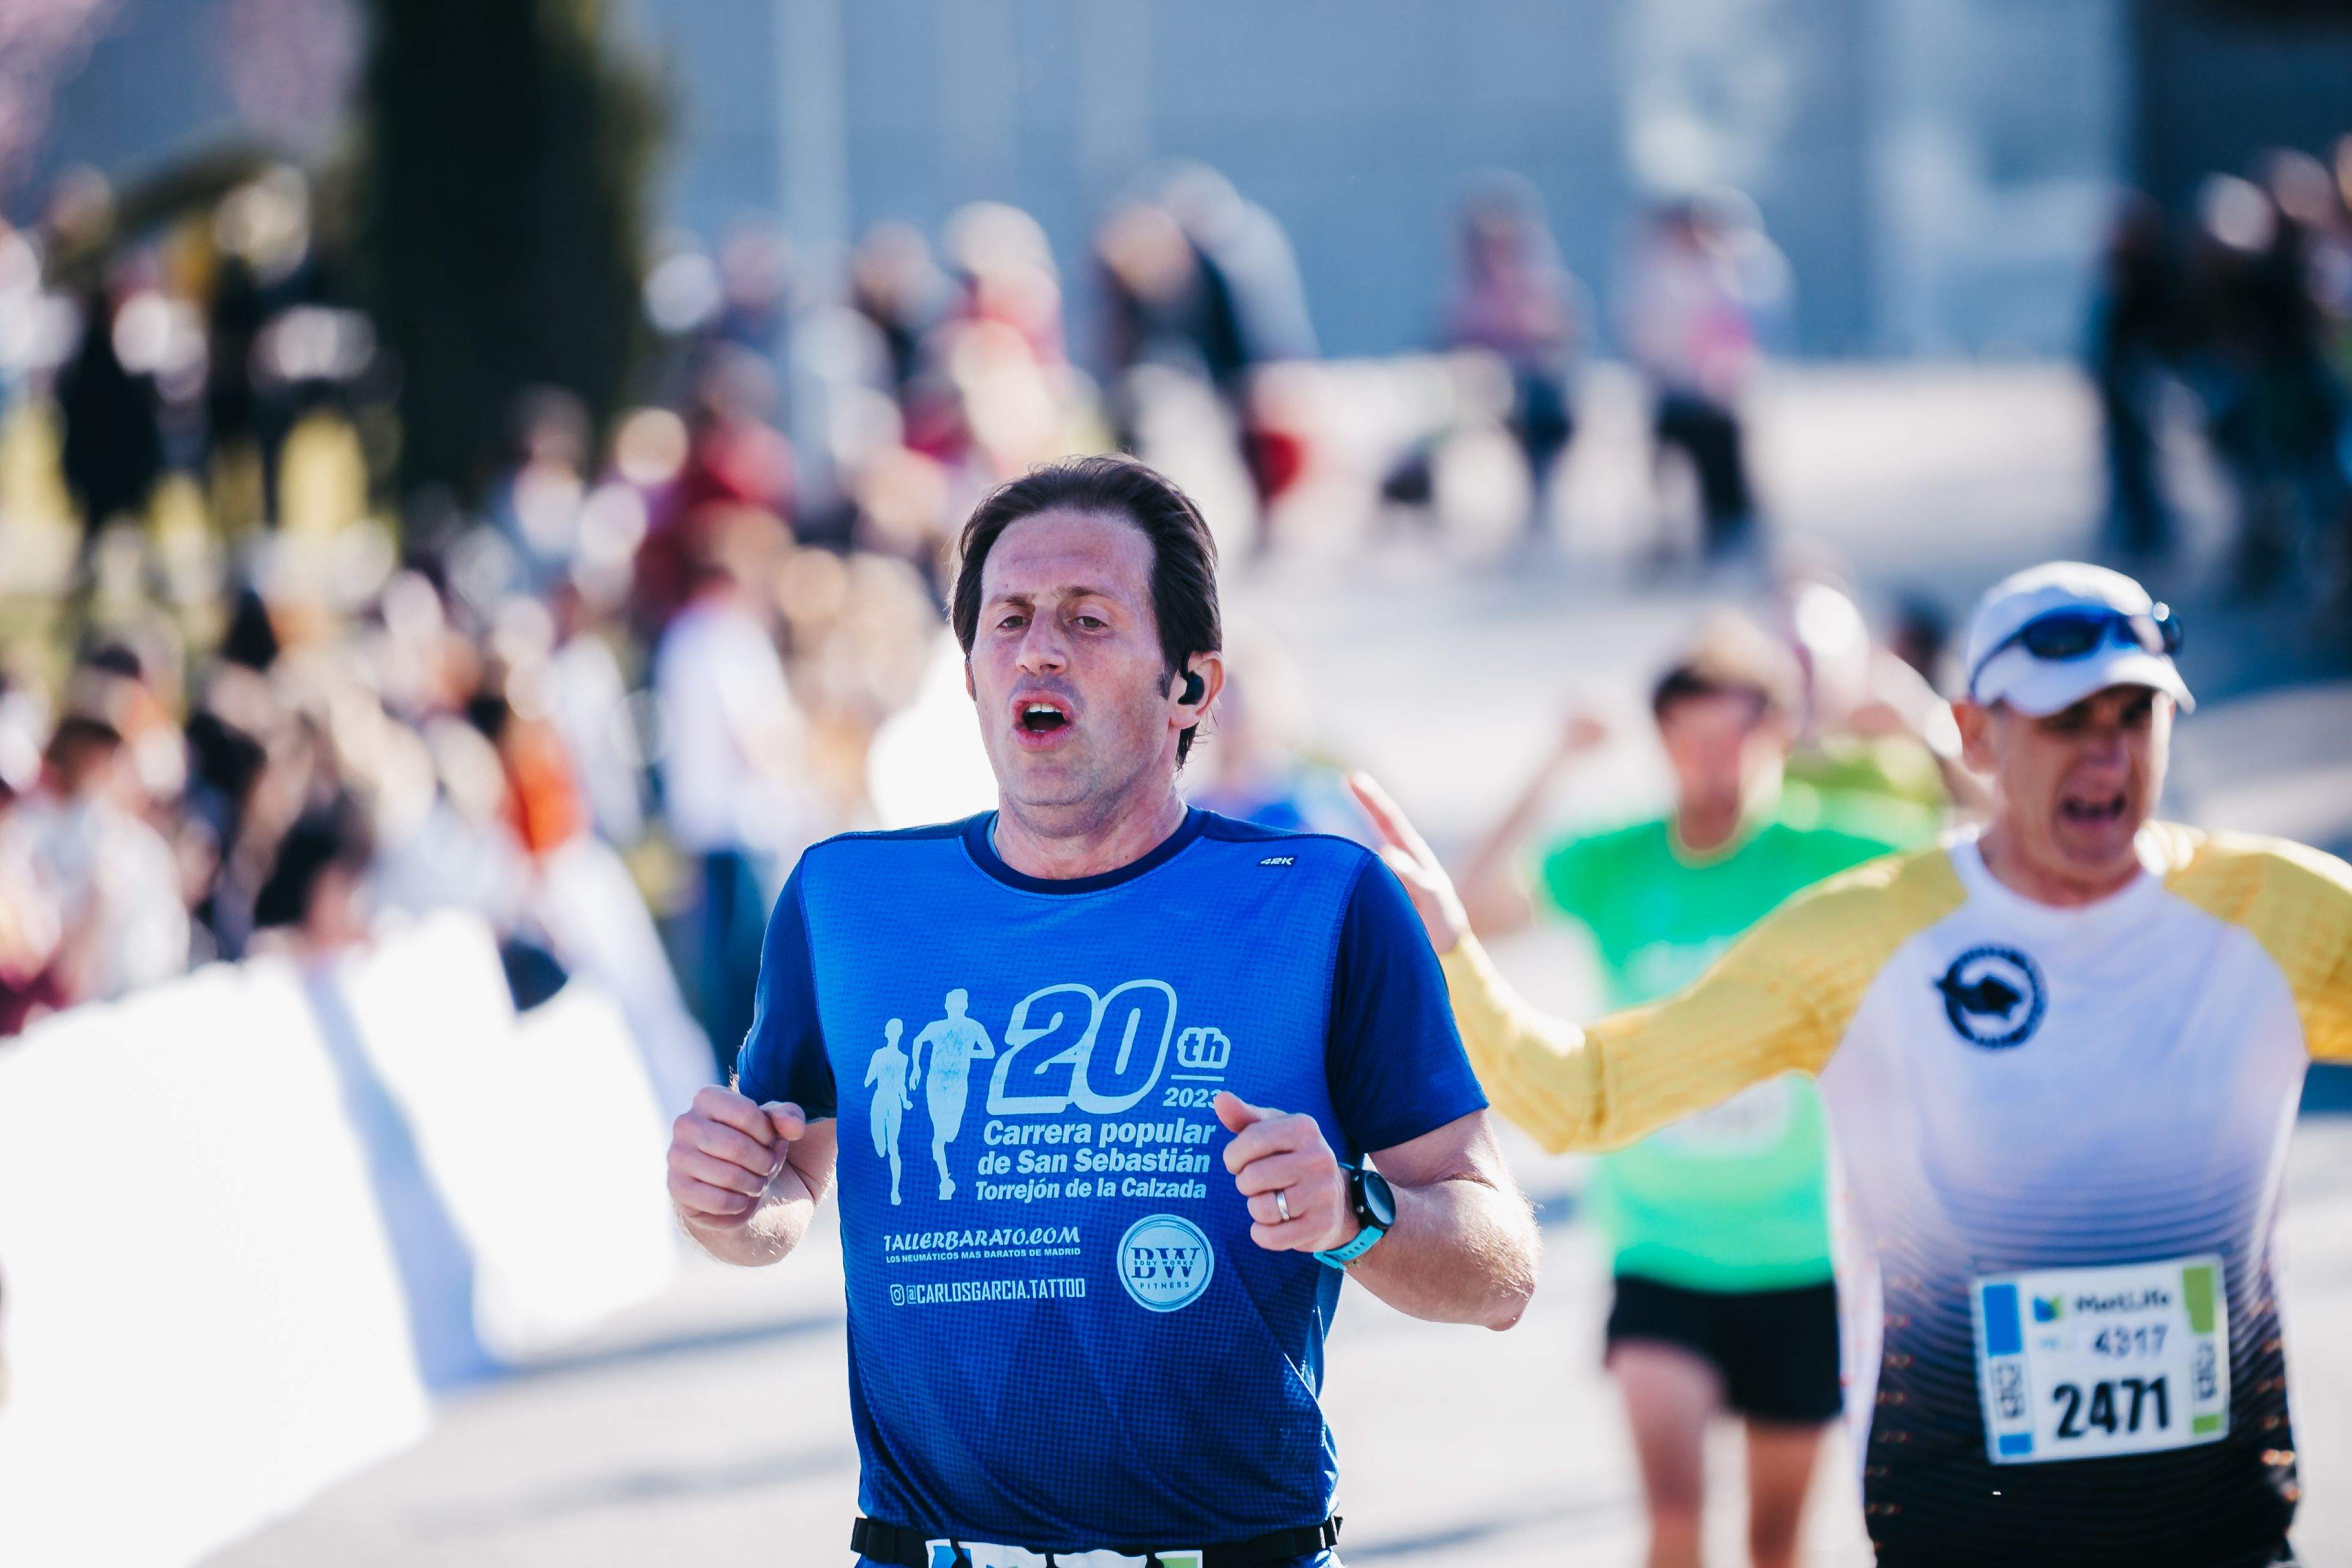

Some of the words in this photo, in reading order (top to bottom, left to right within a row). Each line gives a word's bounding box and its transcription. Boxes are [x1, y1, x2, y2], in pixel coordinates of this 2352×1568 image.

[986, 979, 1177, 1115] 20
[1178, 1028, 1230, 1068] th
[983, 1120, 1092, 1146] Carrera
[1098, 1118, 1216, 1148] popular
[978, 1151, 1011, 1175] de
[1016, 1149, 1068, 1174] San
[1074, 1148, 1210, 1173] Sebastián
[975, 1178, 1060, 1203] Torrejón
[1065, 1178, 1092, 1198] de
[1096, 1177, 1116, 1197] la
[1122, 1177, 1207, 1198] Calzada
[902, 1252, 959, 1263] NEUMÁTICOS
[961, 1250, 981, 1260] MAS
[984, 1249, 1027, 1258] BARATOS
[1044, 1247, 1081, 1256] MADRID
[1131, 1247, 1200, 1279] BW
[906, 1278, 1085, 1304] @CARLOSGARCIA.TATTOO
[2053, 1375, 2169, 1440] 2471
